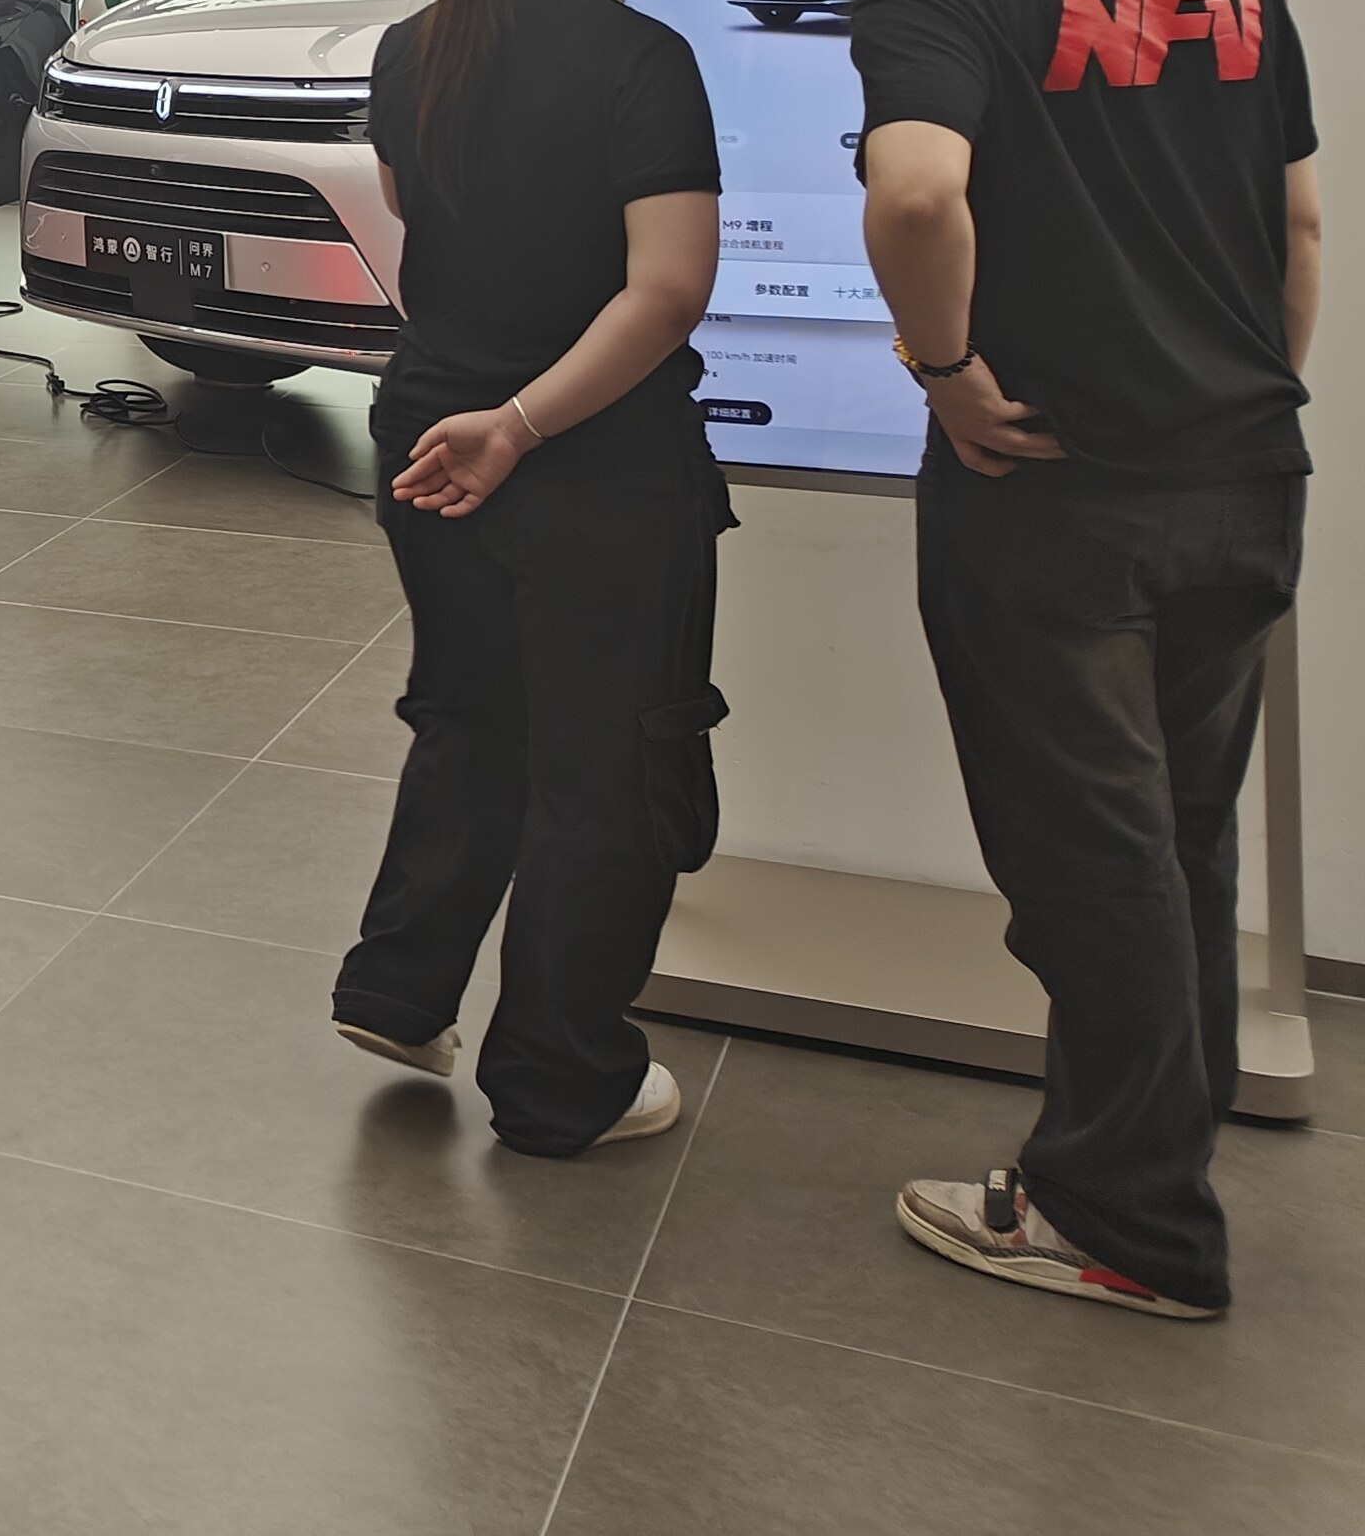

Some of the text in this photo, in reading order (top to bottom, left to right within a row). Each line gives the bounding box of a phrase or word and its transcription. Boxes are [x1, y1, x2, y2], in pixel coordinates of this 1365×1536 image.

[722, 220, 773, 232] M9 增程
[145, 244, 173, 263] 智行
[189, 241, 214, 257] 问界
[755, 283, 809, 297] 参数配置
